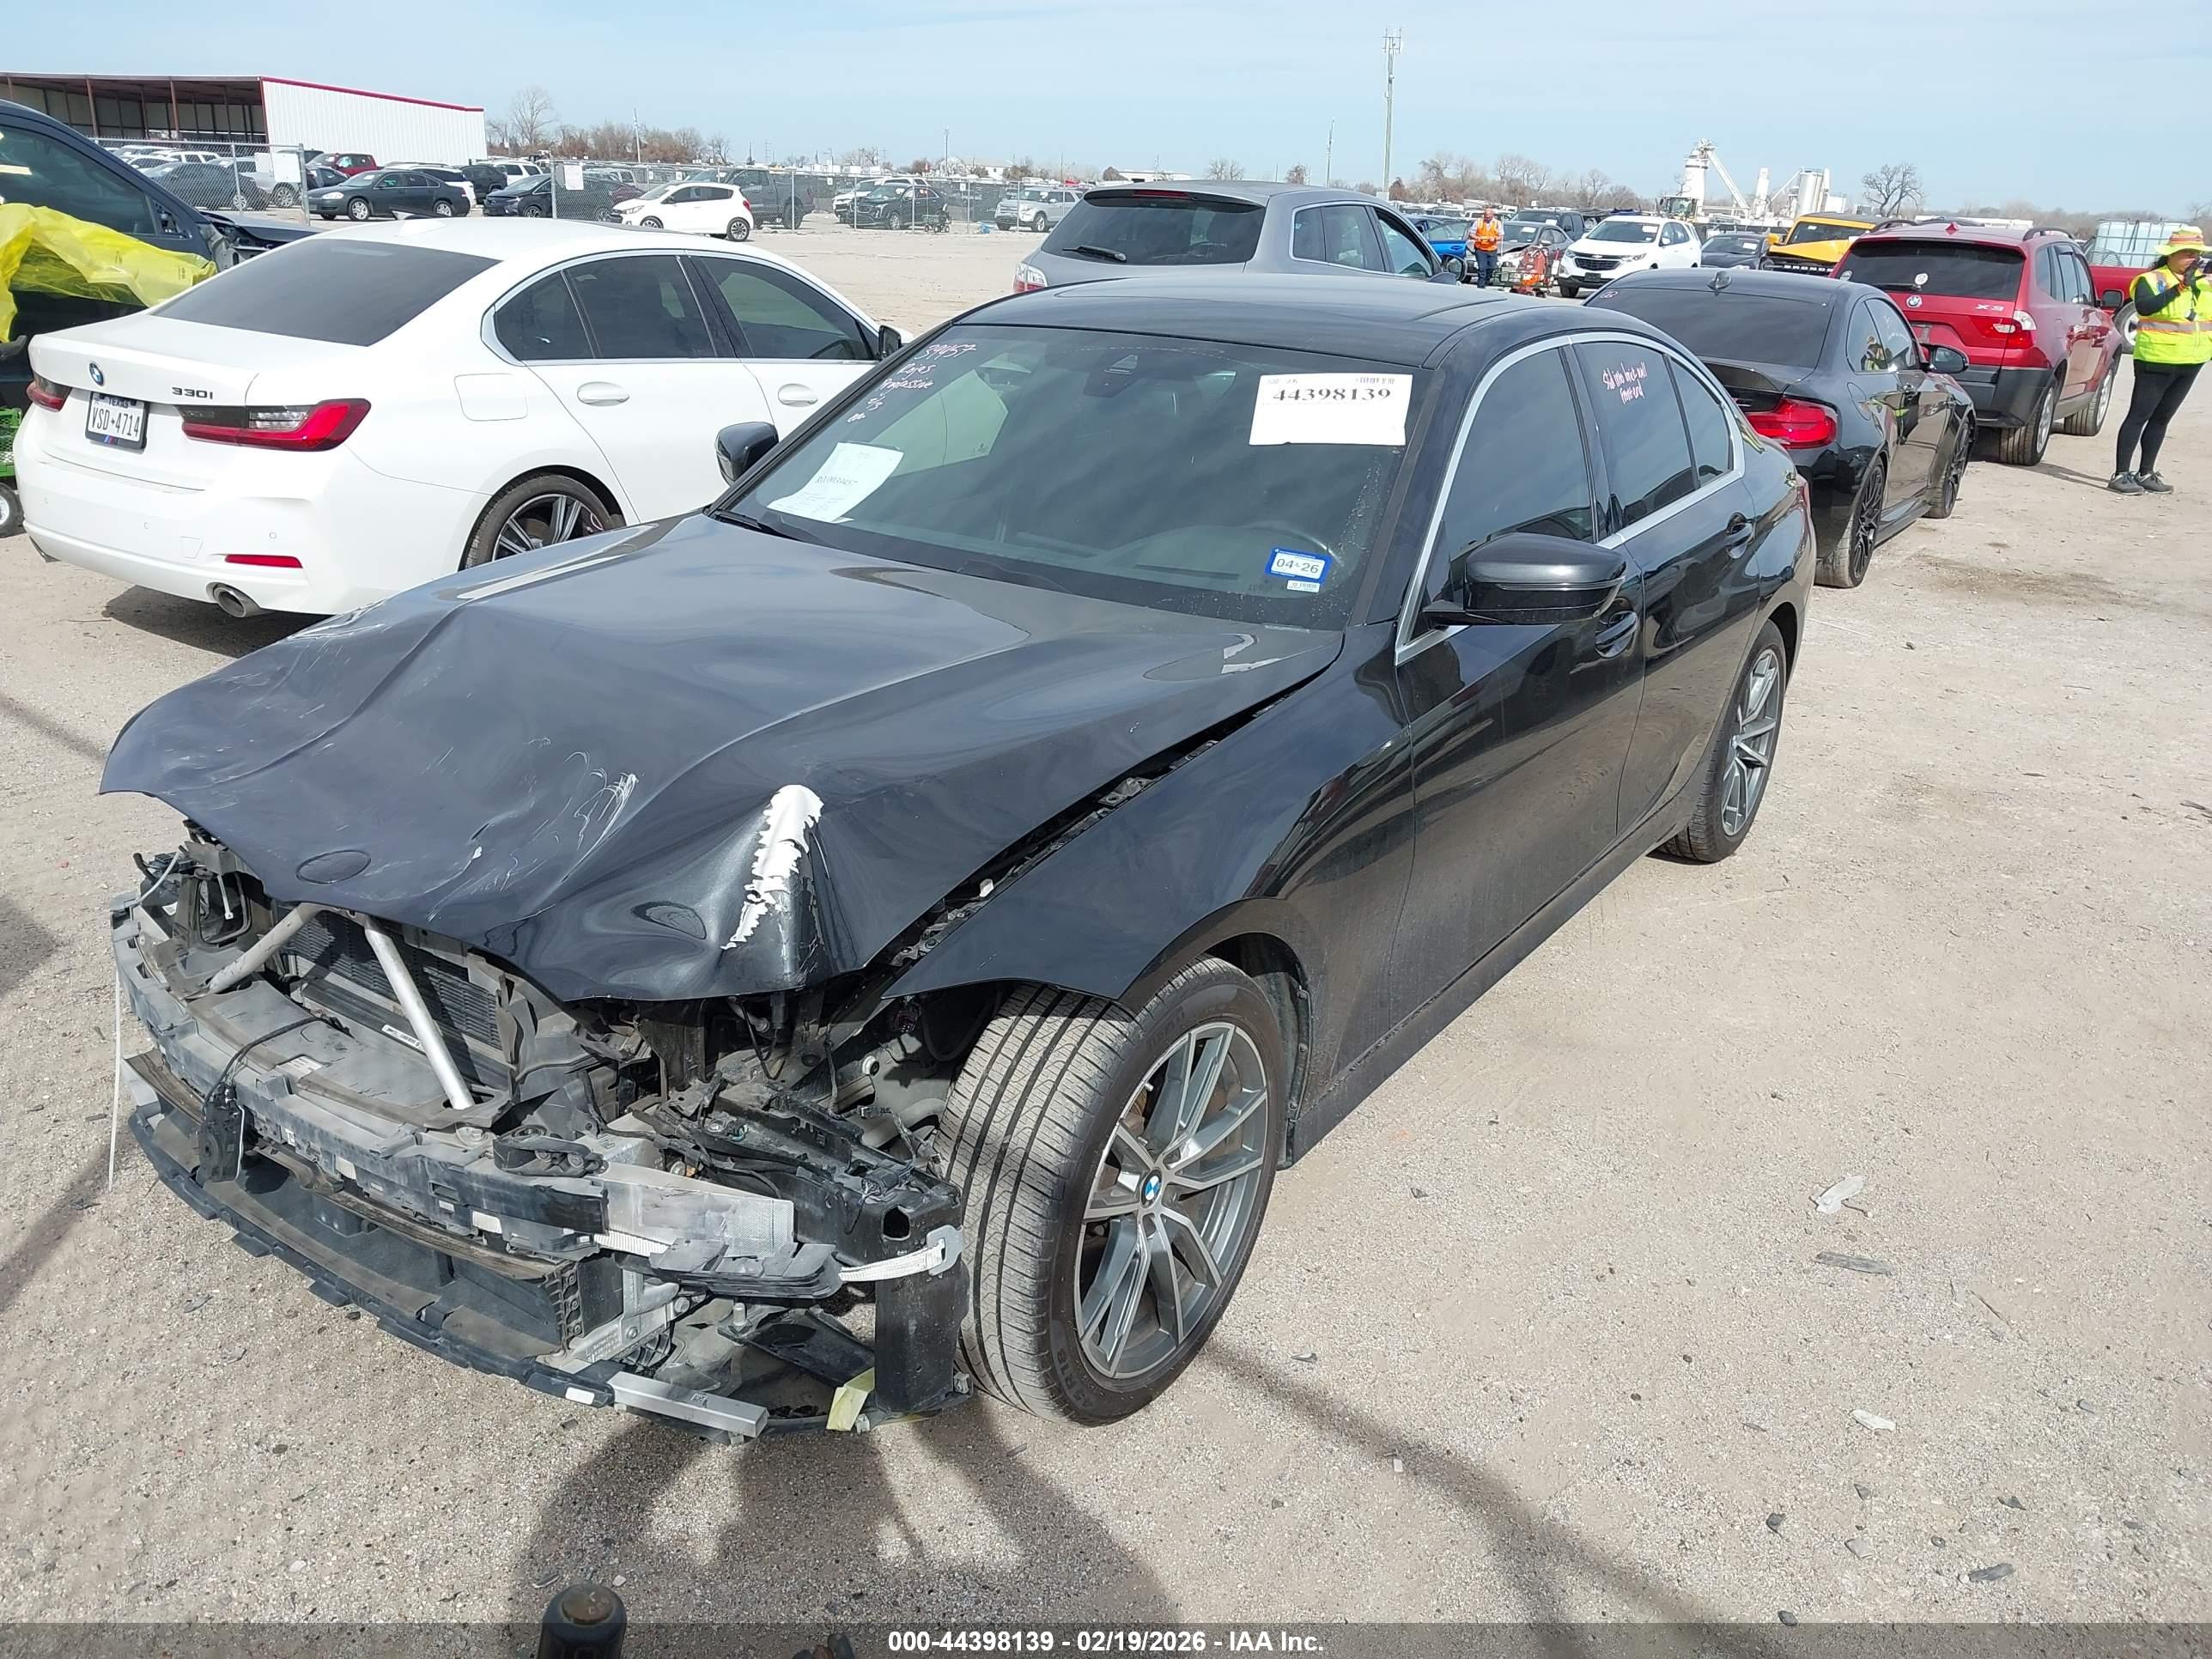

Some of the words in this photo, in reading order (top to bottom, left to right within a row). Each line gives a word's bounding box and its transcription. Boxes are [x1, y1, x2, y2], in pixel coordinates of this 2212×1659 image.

[1975, 303, 2004, 312] X3
[172, 386, 213, 399] 330i
[1273, 388, 1391, 401] 44398139
[108, 398, 129, 409] TEXAS
